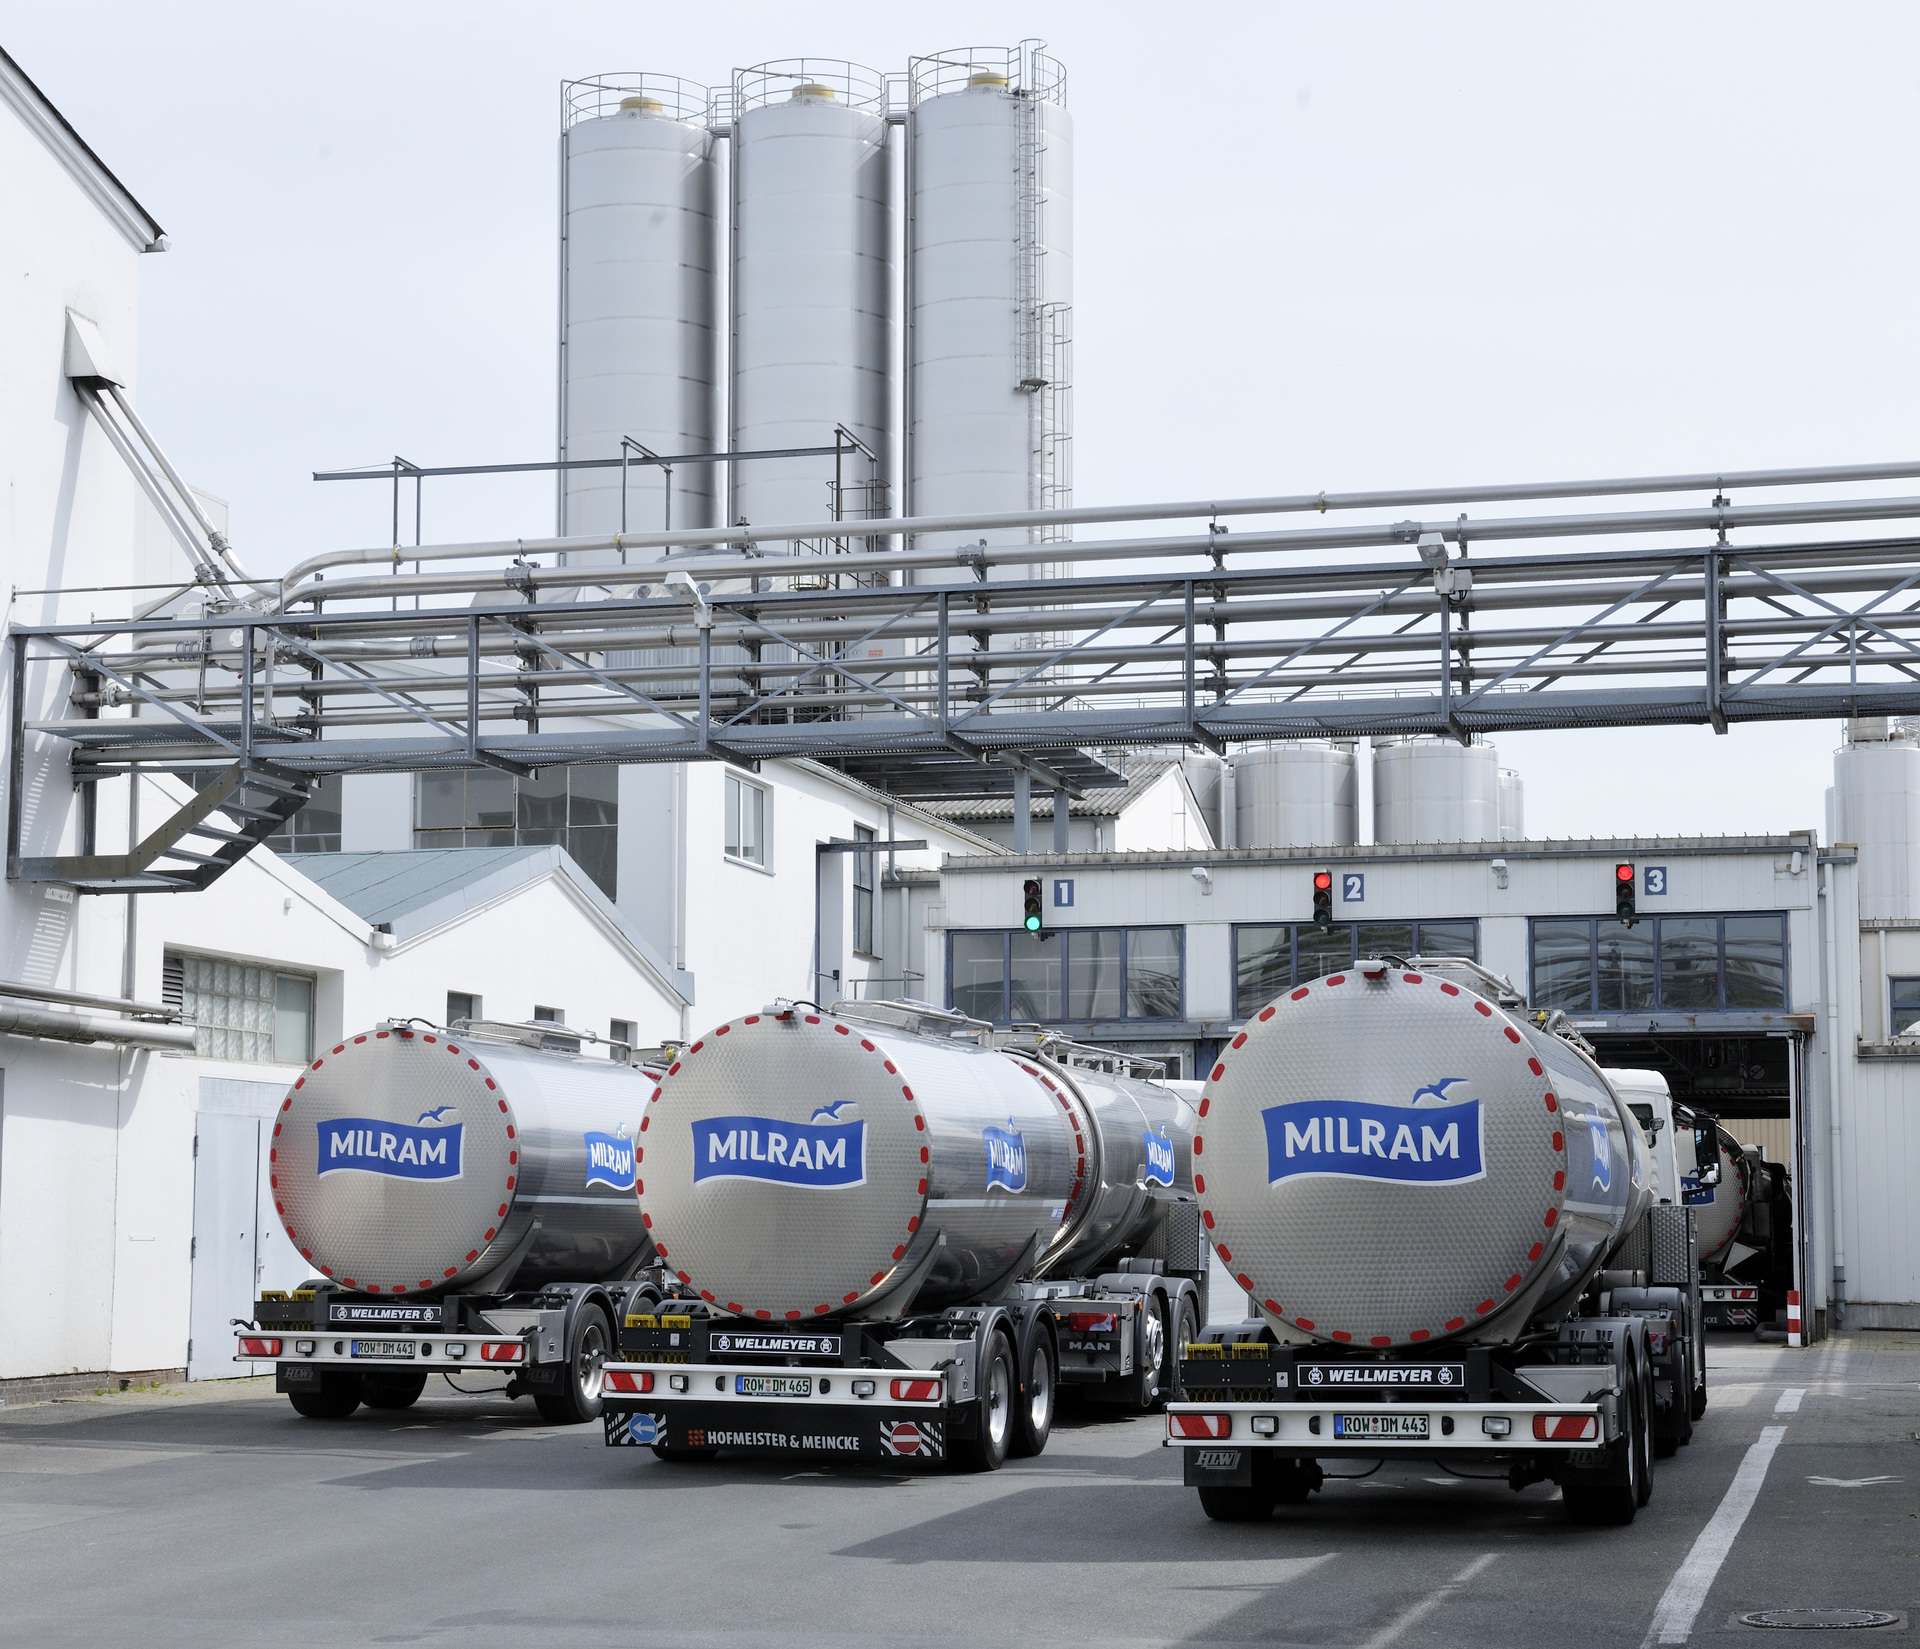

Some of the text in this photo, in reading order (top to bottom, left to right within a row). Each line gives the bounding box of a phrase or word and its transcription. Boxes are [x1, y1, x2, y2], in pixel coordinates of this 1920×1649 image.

[1346, 876, 1361, 898] 2
[1648, 869, 1663, 892] 3
[1059, 883, 1068, 904] 1
[330, 1130, 447, 1166] MILRAM
[708, 1130, 846, 1170] MILRAM
[1283, 1117, 1460, 1162] MILRAM
[590, 1142, 631, 1175] MILRAM
[989, 1138, 1023, 1176] MILRAM
[351, 1308, 420, 1319] WELLMEYER
[358, 1342, 376, 1353] ROW
[396, 1343, 414, 1355] 441
[735, 1338, 817, 1351] WELLMEYER
[1069, 1341, 1111, 1351] MAN
[743, 1378, 809, 1393] ROW DM 465
[1329, 1369, 1433, 1382] WELLMEYER
[1344, 1417, 1427, 1433] ROW DM 443
[707, 1430, 860, 1451] HOFMEISTER & MEINCKE
